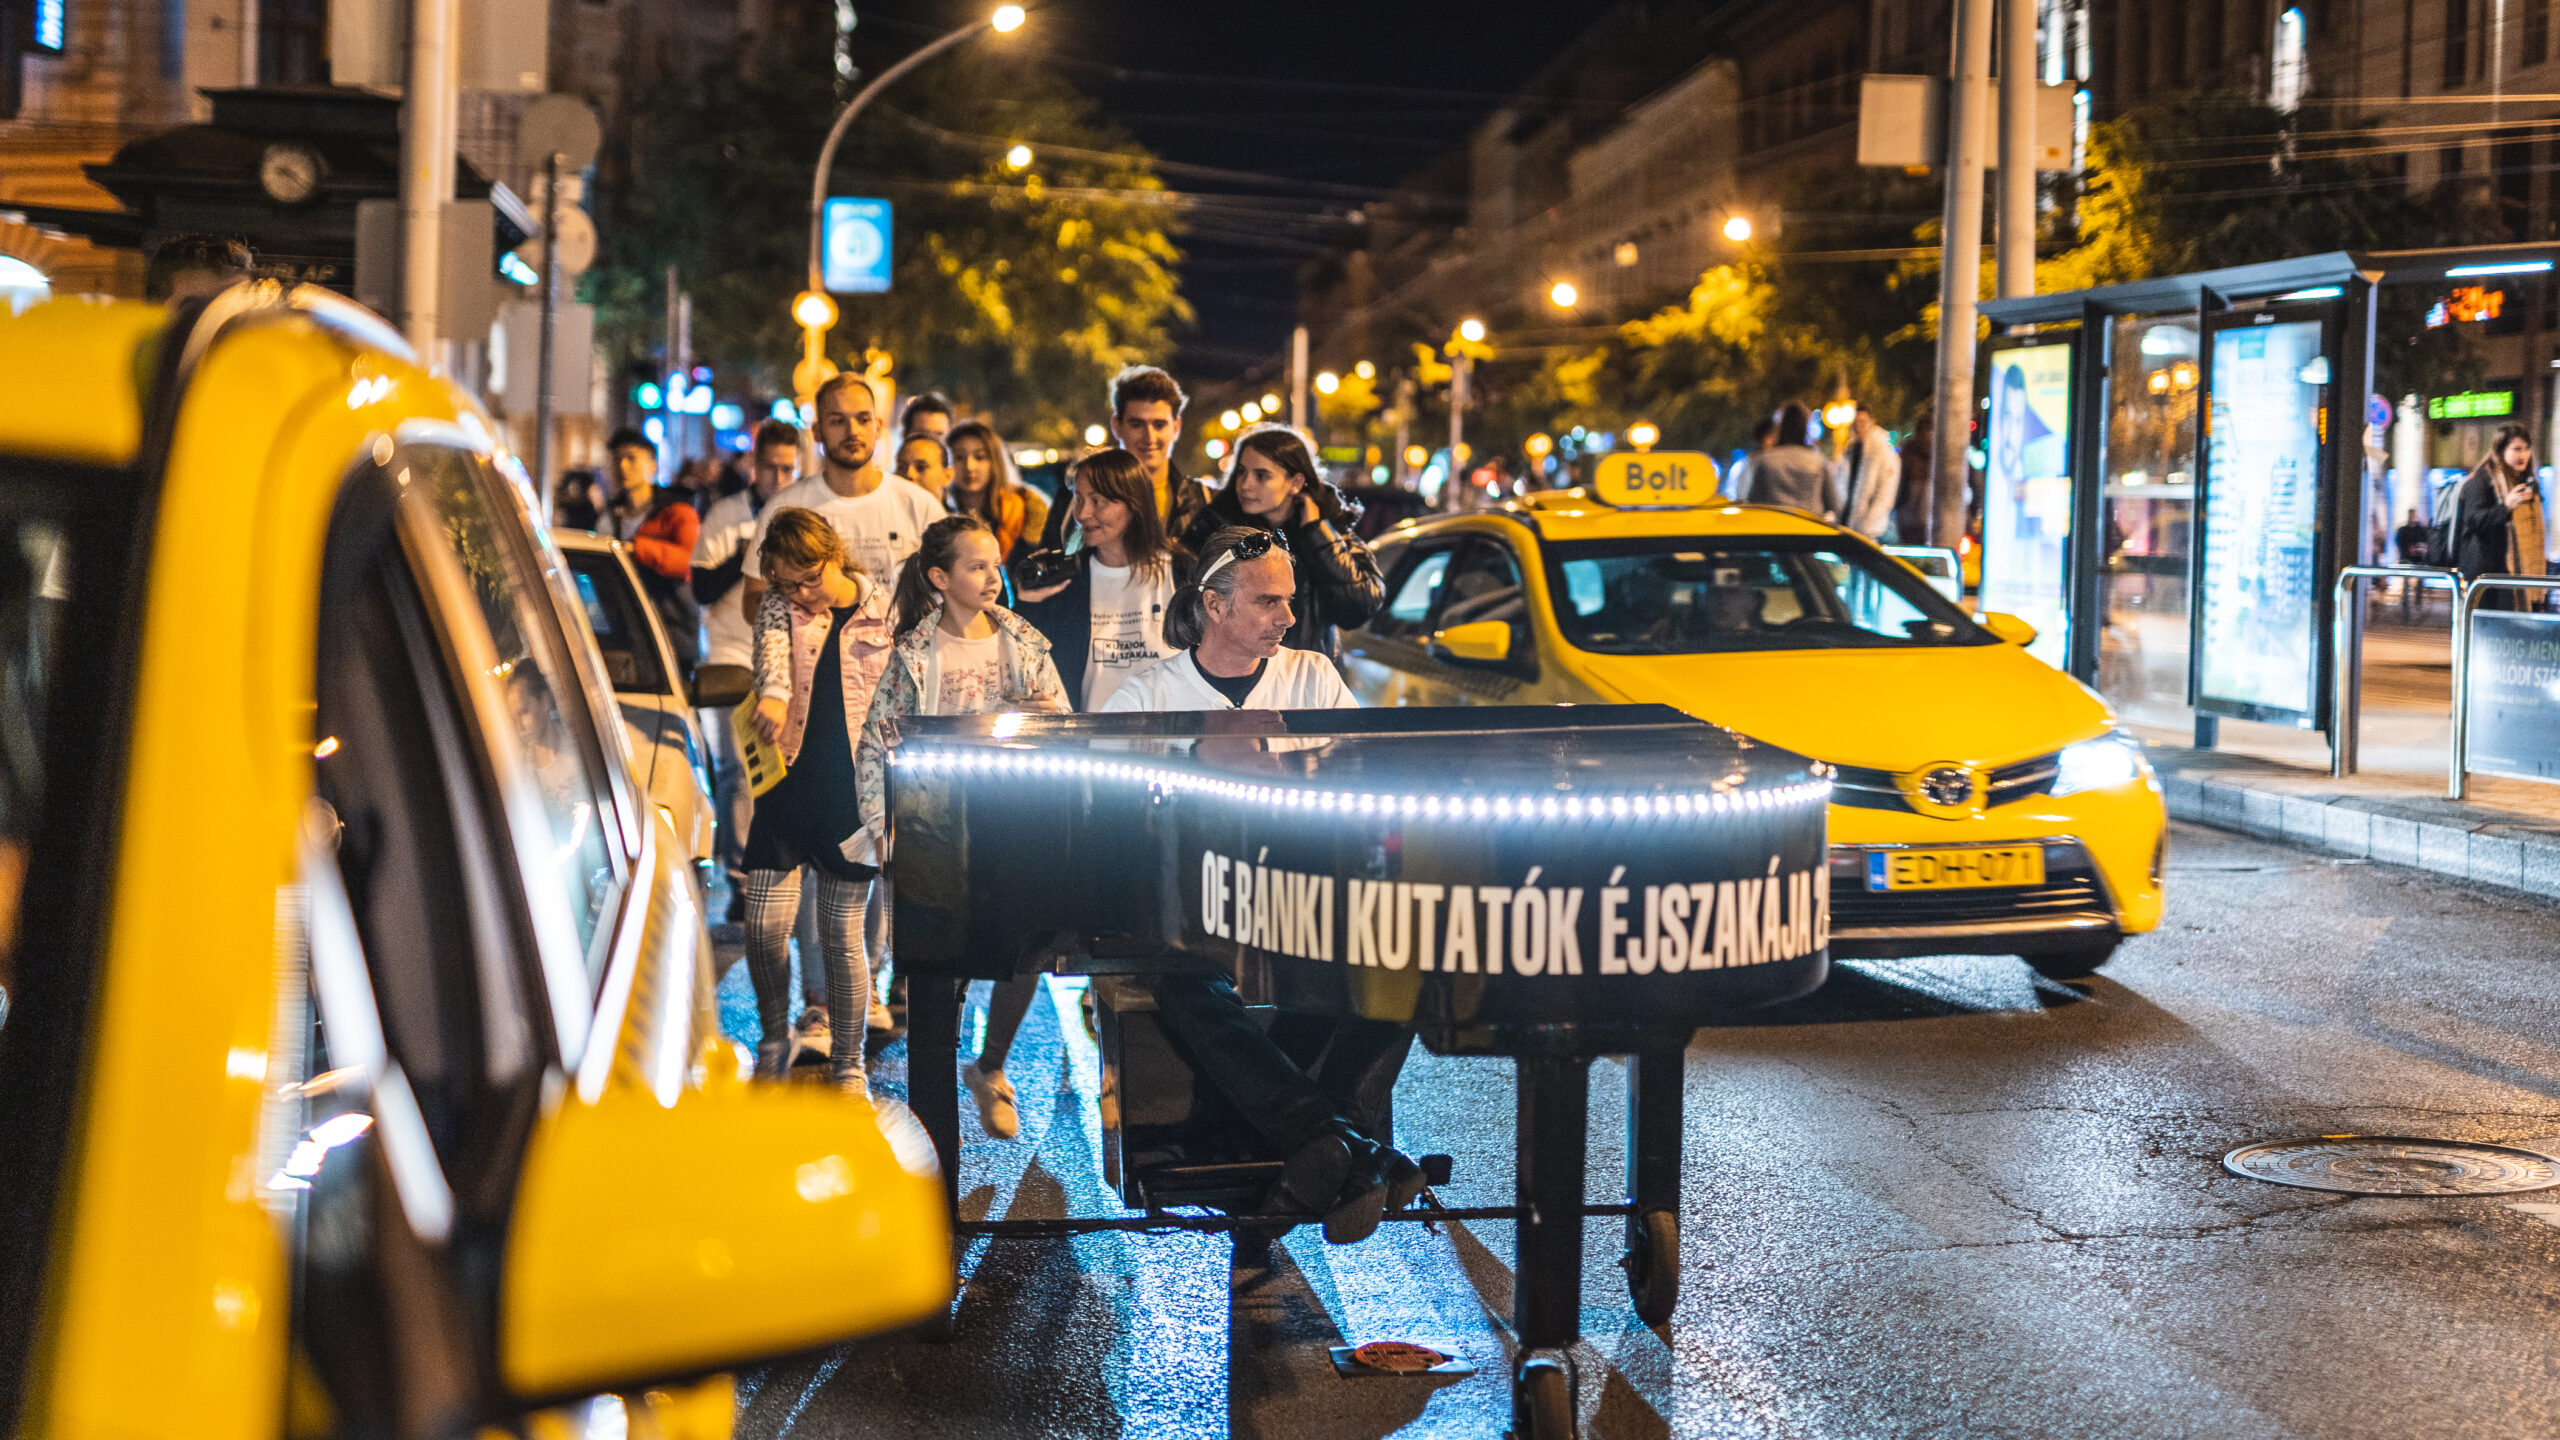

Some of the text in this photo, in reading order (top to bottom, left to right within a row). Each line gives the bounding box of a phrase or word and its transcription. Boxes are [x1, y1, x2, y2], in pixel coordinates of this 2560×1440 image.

[1626, 462, 1688, 490] Bolt
[1897, 852, 2031, 884] EDH-071
[1202, 850, 1230, 939] OE
[1235, 846, 1334, 963] BÁNKI
[1347, 865, 1584, 977] KUTATÓK
[1601, 854, 1811, 976] ÉJSZAKÁJA
